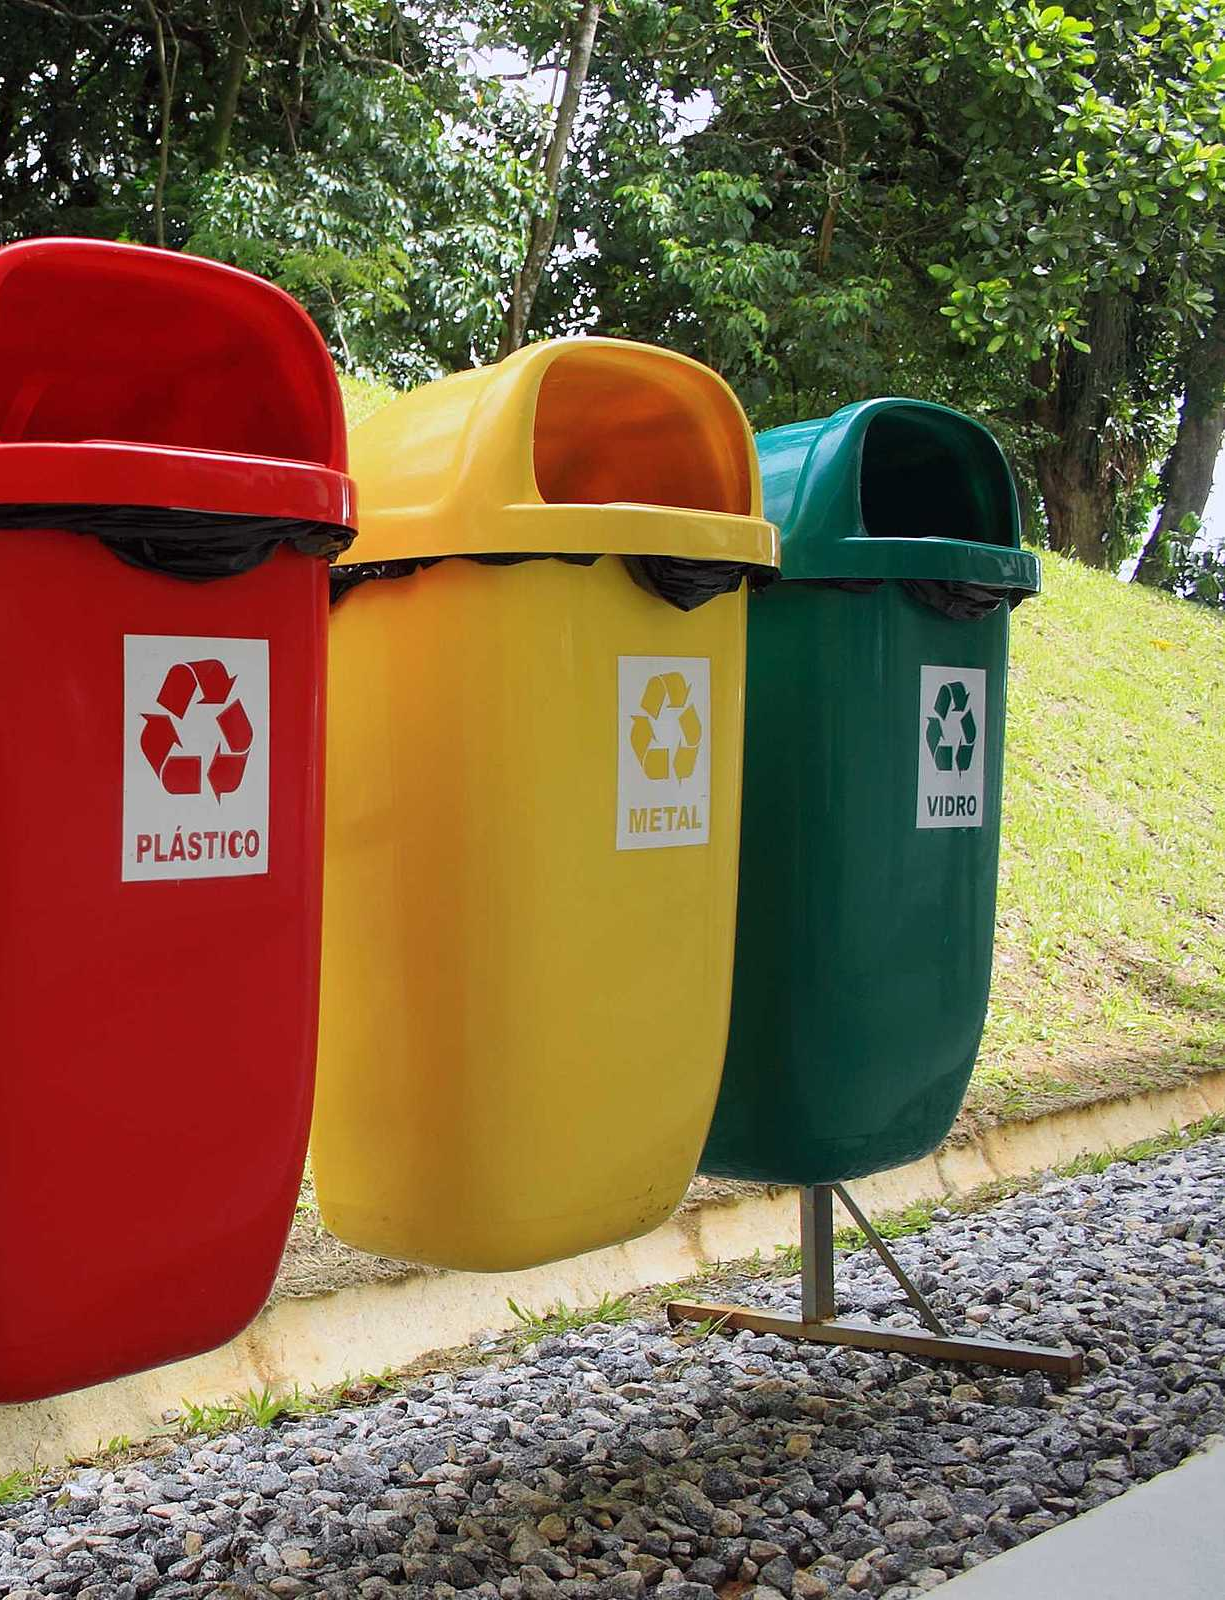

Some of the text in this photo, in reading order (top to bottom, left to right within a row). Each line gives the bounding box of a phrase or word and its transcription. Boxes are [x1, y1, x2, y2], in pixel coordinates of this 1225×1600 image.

[629, 805, 703, 833] METAL
[927, 795, 977, 817] VIDRO
[136, 825, 260, 863] PLÁSTICO
